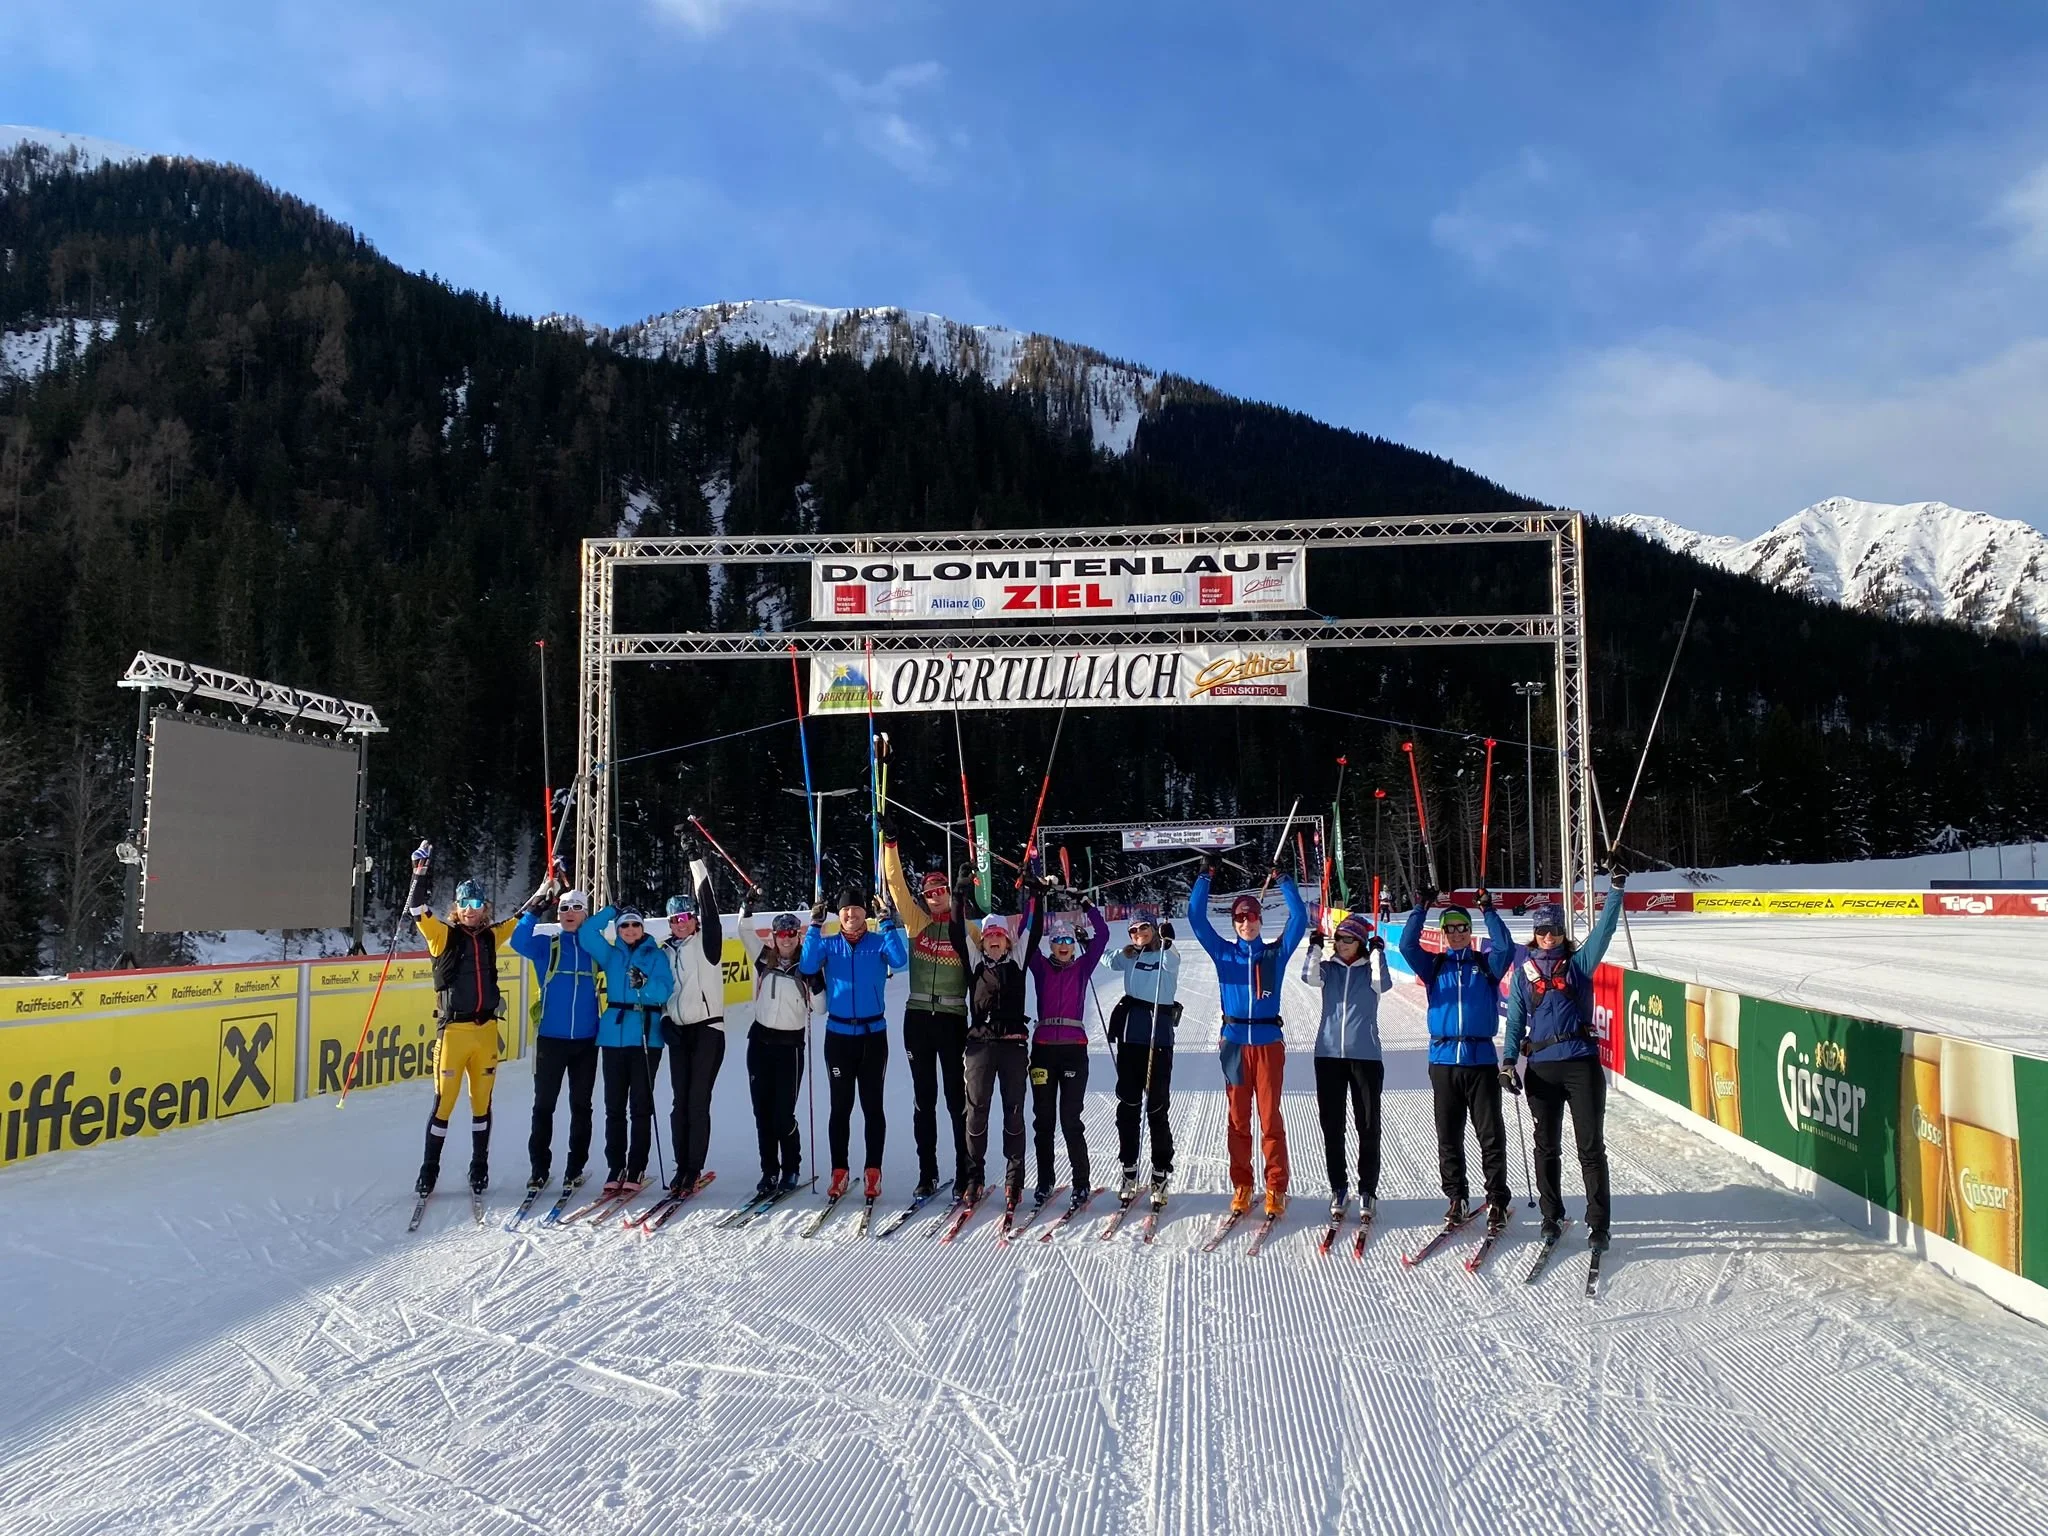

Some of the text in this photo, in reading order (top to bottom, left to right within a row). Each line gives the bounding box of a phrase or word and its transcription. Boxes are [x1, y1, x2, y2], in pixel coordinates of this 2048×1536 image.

[821, 551, 1297, 582] DOLOMITENLAUF
[931, 598, 969, 609] Allianz
[1002, 584, 1112, 609] ZIEL
[1128, 593, 1167, 603] Allianz
[891, 653, 1182, 705] OBERTILLIACH
[1191, 648, 1300, 696] Osttirol
[1696, 898, 1752, 908] FISCHER
[1769, 900, 1824, 909] FISCHER
[1841, 899, 1907, 909] FISCHER
[1940, 895, 1993, 914] Tirol
[235, 980, 270, 993] Raiffeisen
[321, 973, 351, 985] Raiffeisen
[100, 992, 144, 1006] Raiffeisen
[171, 986, 212, 999] Raiffeisen
[16, 998, 69, 1013] Raiffeisen
[1628, 989, 1673, 1061] Gösser
[318, 1023, 437, 1095] Raiffeis
[1777, 1031, 1866, 1137] Gösser
[0, 1066, 210, 1162] iffeisen
[1912, 1104, 1943, 1149] Gösse
[1960, 1167, 2009, 1214] Gösser
